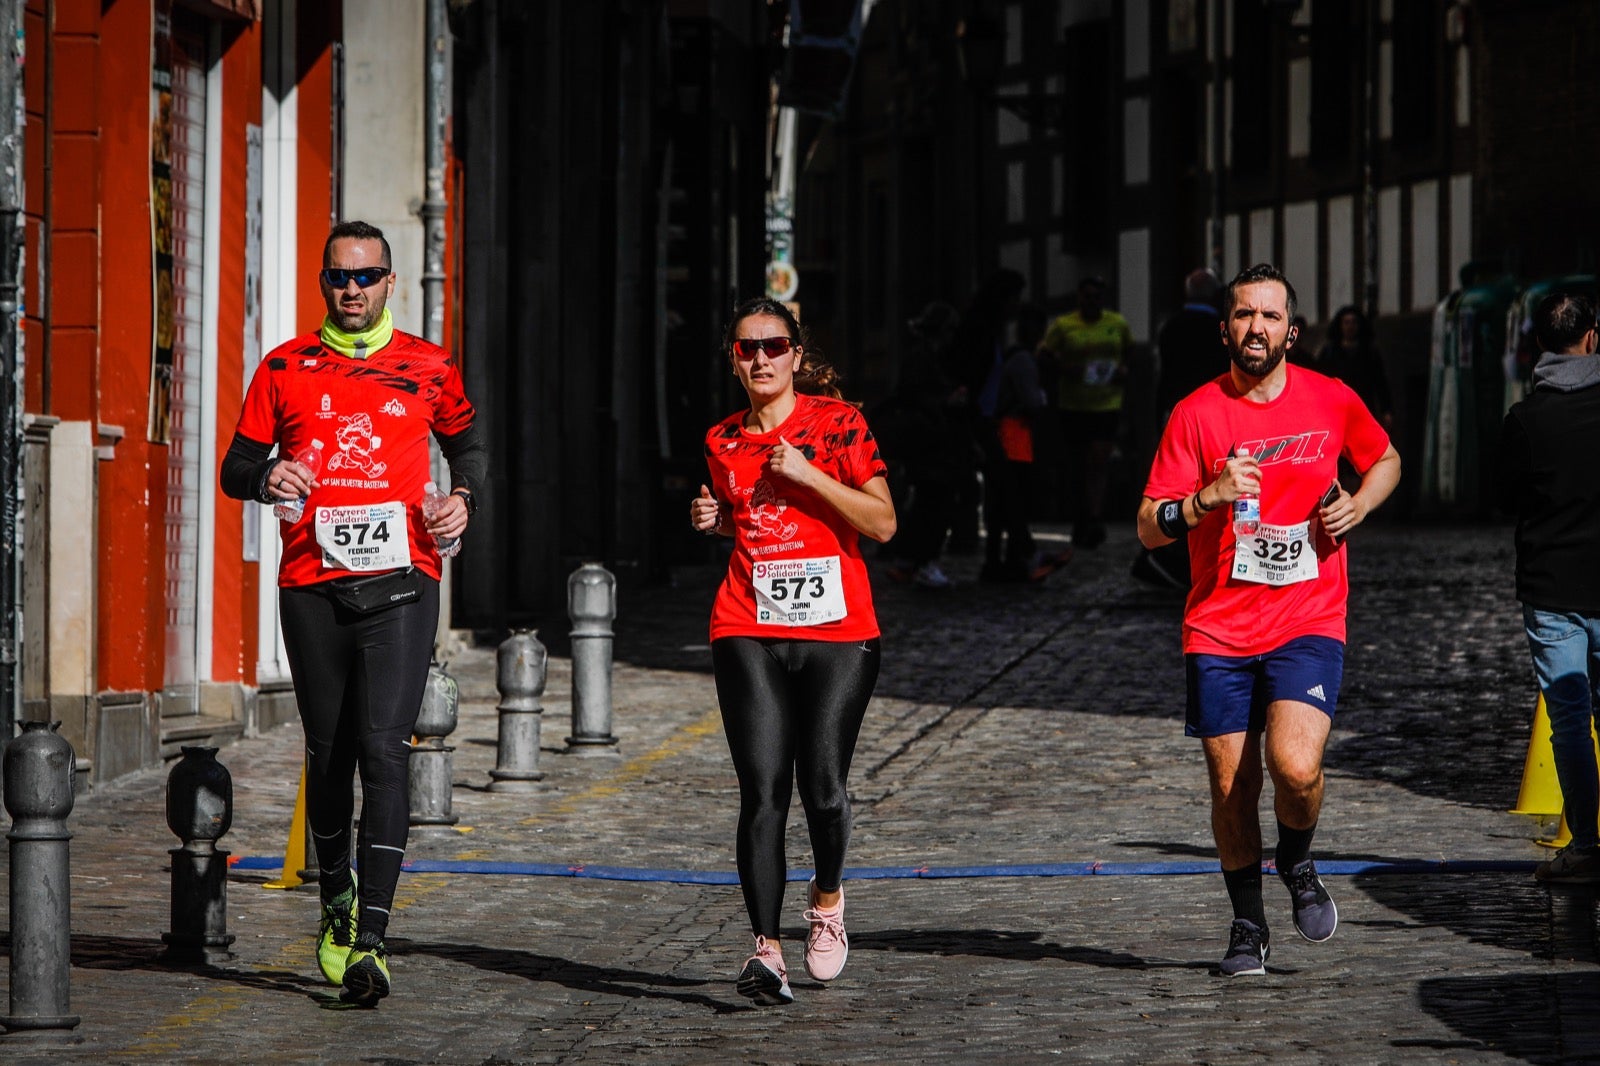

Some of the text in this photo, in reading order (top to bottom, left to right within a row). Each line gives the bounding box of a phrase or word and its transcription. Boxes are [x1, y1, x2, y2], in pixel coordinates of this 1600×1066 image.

[330, 478, 340, 486] SAN
[341, 479, 363, 488] SILVESTRE
[364, 480, 389, 489] BASTETANA
[320, 509, 331, 524] 9
[332, 508, 366, 517] Carrera
[331, 515, 370, 524] Solidaria
[334, 521, 389, 546] 574
[1260, 526, 1287, 535] arrera
[1256, 531, 1289, 542] olidaria
[348, 546, 379, 555] FEDERICO
[1253, 538, 1303, 562] 329
[757, 564, 767, 578] 9
[767, 562, 802, 571] Carrera
[1259, 561, 1299, 572] SACAMUELAS
[767, 569, 806, 578] Solidaria
[771, 576, 825, 601] 573
[790, 602, 811, 610] JUANI
